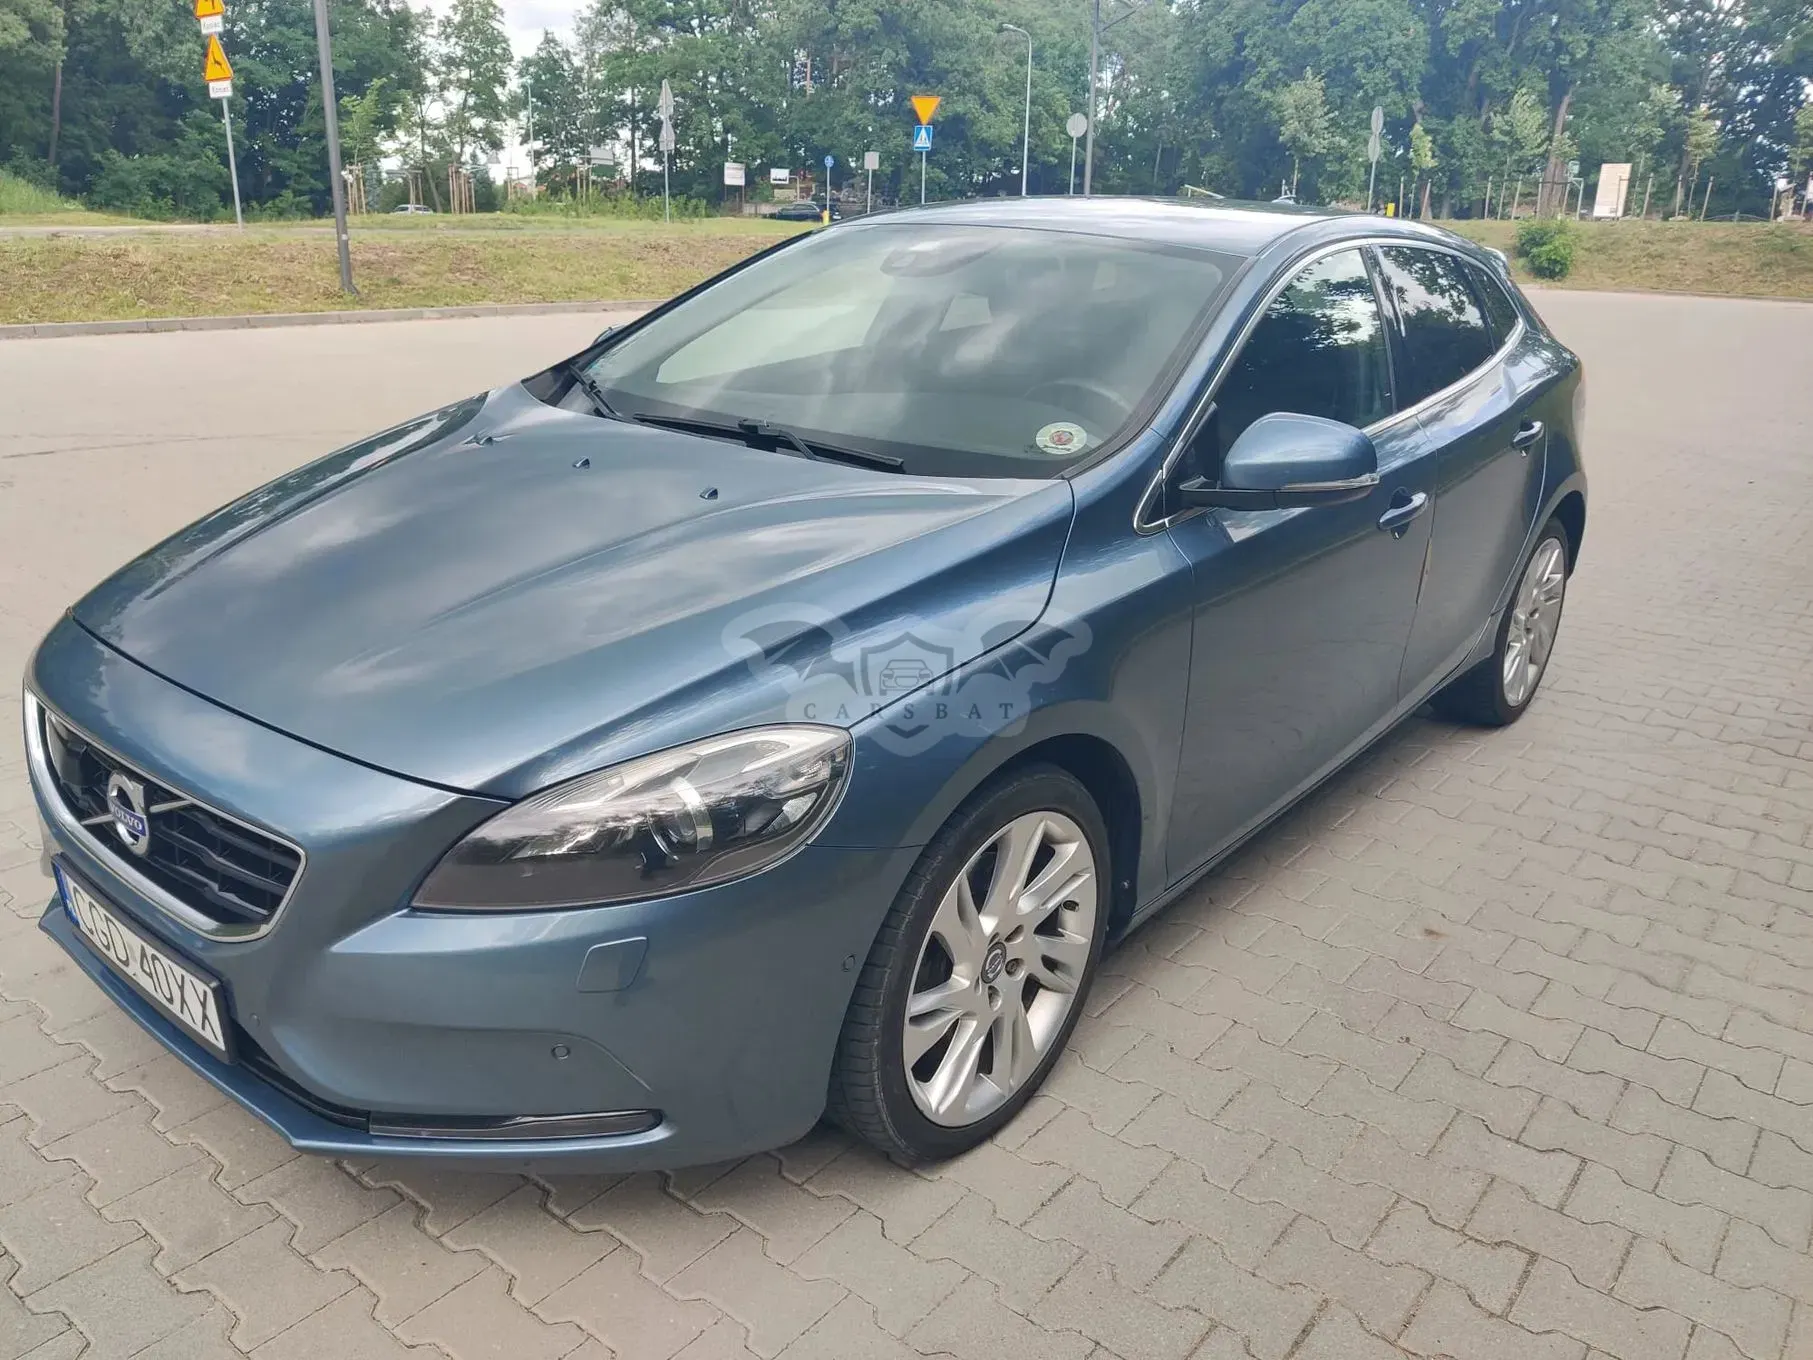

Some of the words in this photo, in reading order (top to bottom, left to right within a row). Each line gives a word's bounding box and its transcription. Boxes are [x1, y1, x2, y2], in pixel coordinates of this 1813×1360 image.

[111, 802, 142, 830] VOLVO
[72, 885, 129, 967] CGD
[139, 944, 219, 1042] 40XX
